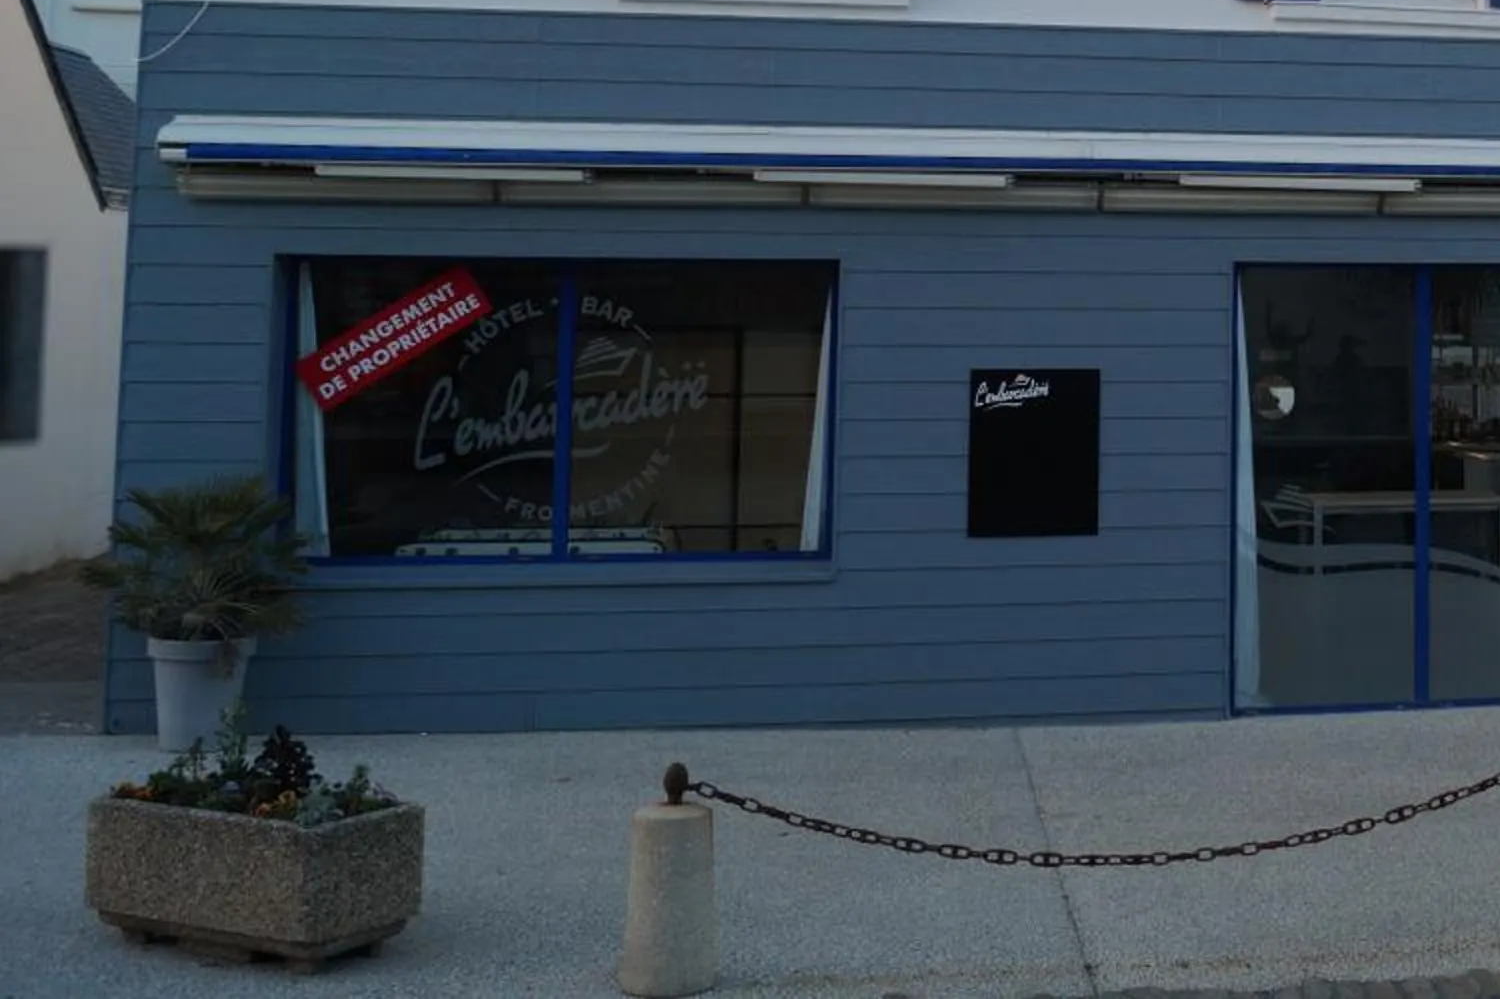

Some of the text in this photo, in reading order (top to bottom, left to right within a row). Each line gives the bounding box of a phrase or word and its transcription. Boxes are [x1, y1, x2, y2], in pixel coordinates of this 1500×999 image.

[318, 293, 482, 400] DE PROPRIÉTAIRE
[320, 281, 457, 373] CHANGEMENT
[463, 297, 633, 354] HÔTEL BAR
[504, 451, 672, 521] FROMENTINE
